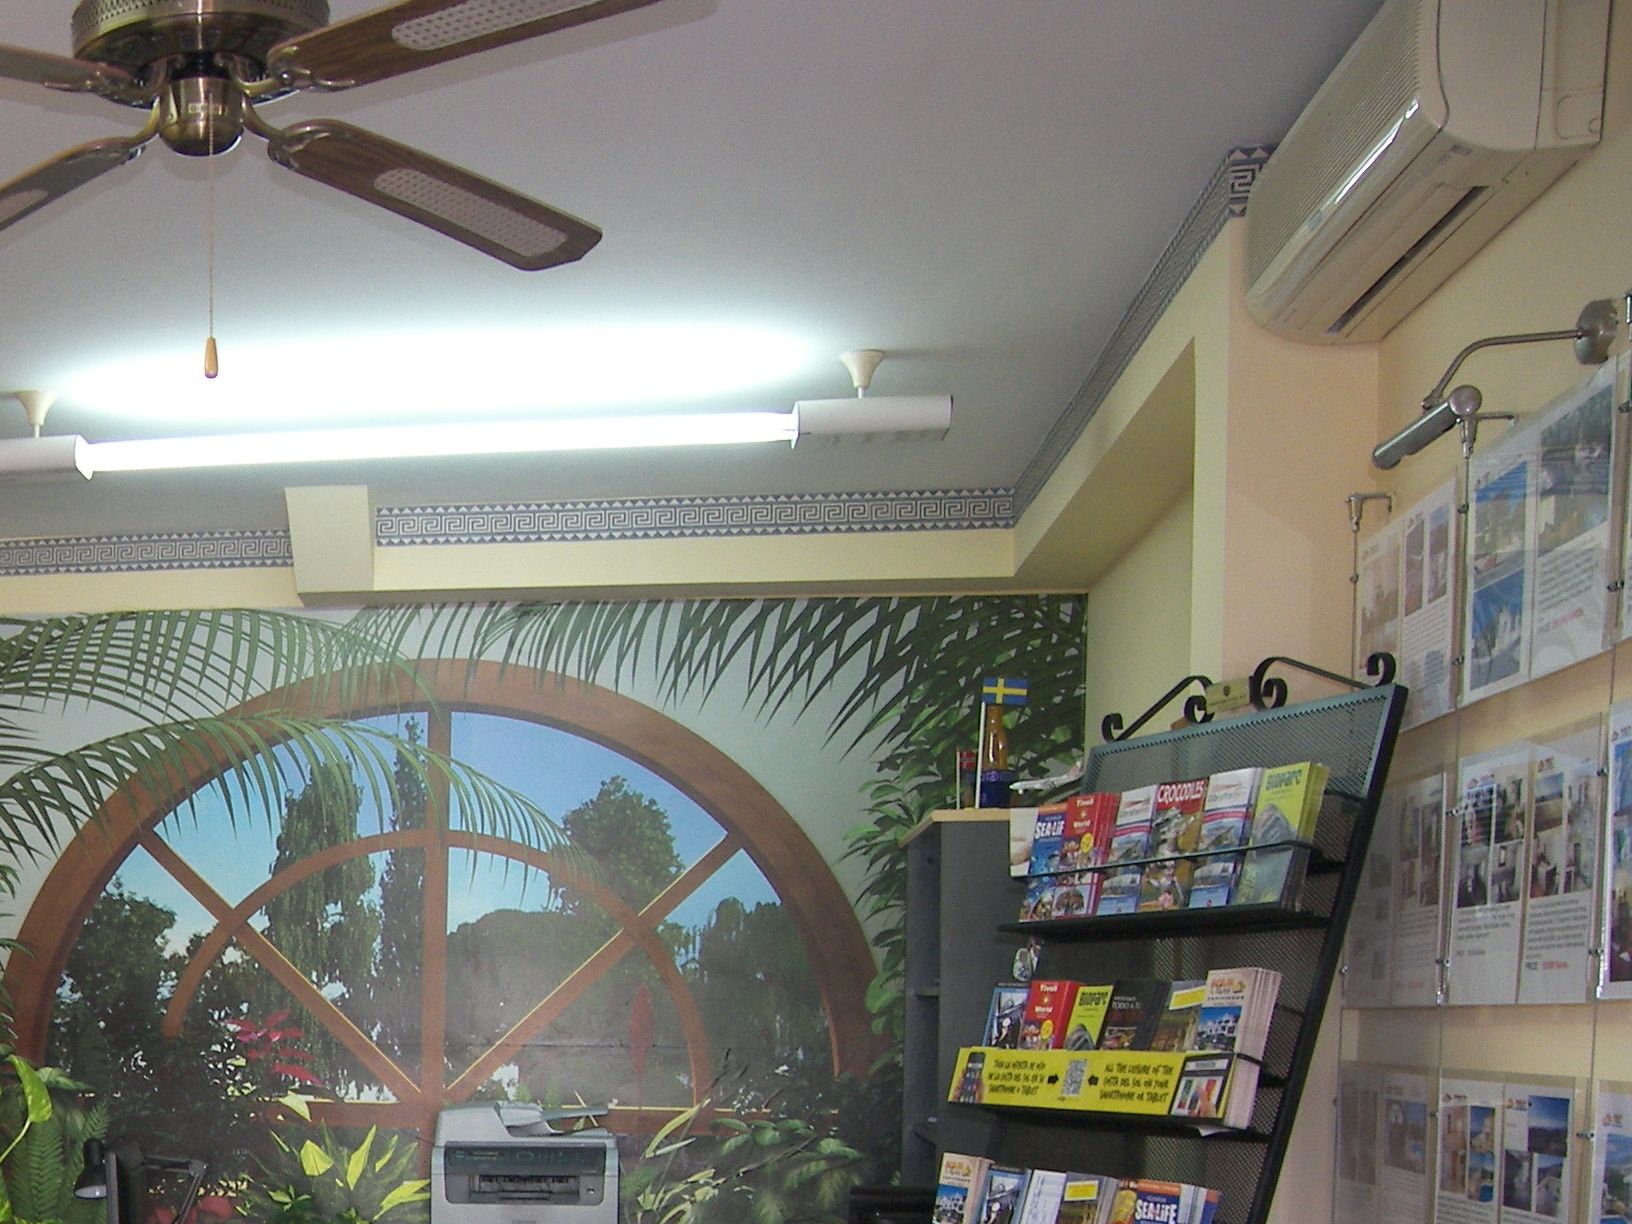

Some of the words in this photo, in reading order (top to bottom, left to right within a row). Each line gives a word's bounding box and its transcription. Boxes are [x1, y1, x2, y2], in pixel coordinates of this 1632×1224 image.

[1156, 780, 1207, 804] CROCODILES
[1076, 798, 1094, 807] Tivoli
[1040, 983, 1059, 993] Tivoli
[1035, 1005, 1054, 1014] World
[1135, 1200, 1154, 1221] SEA
